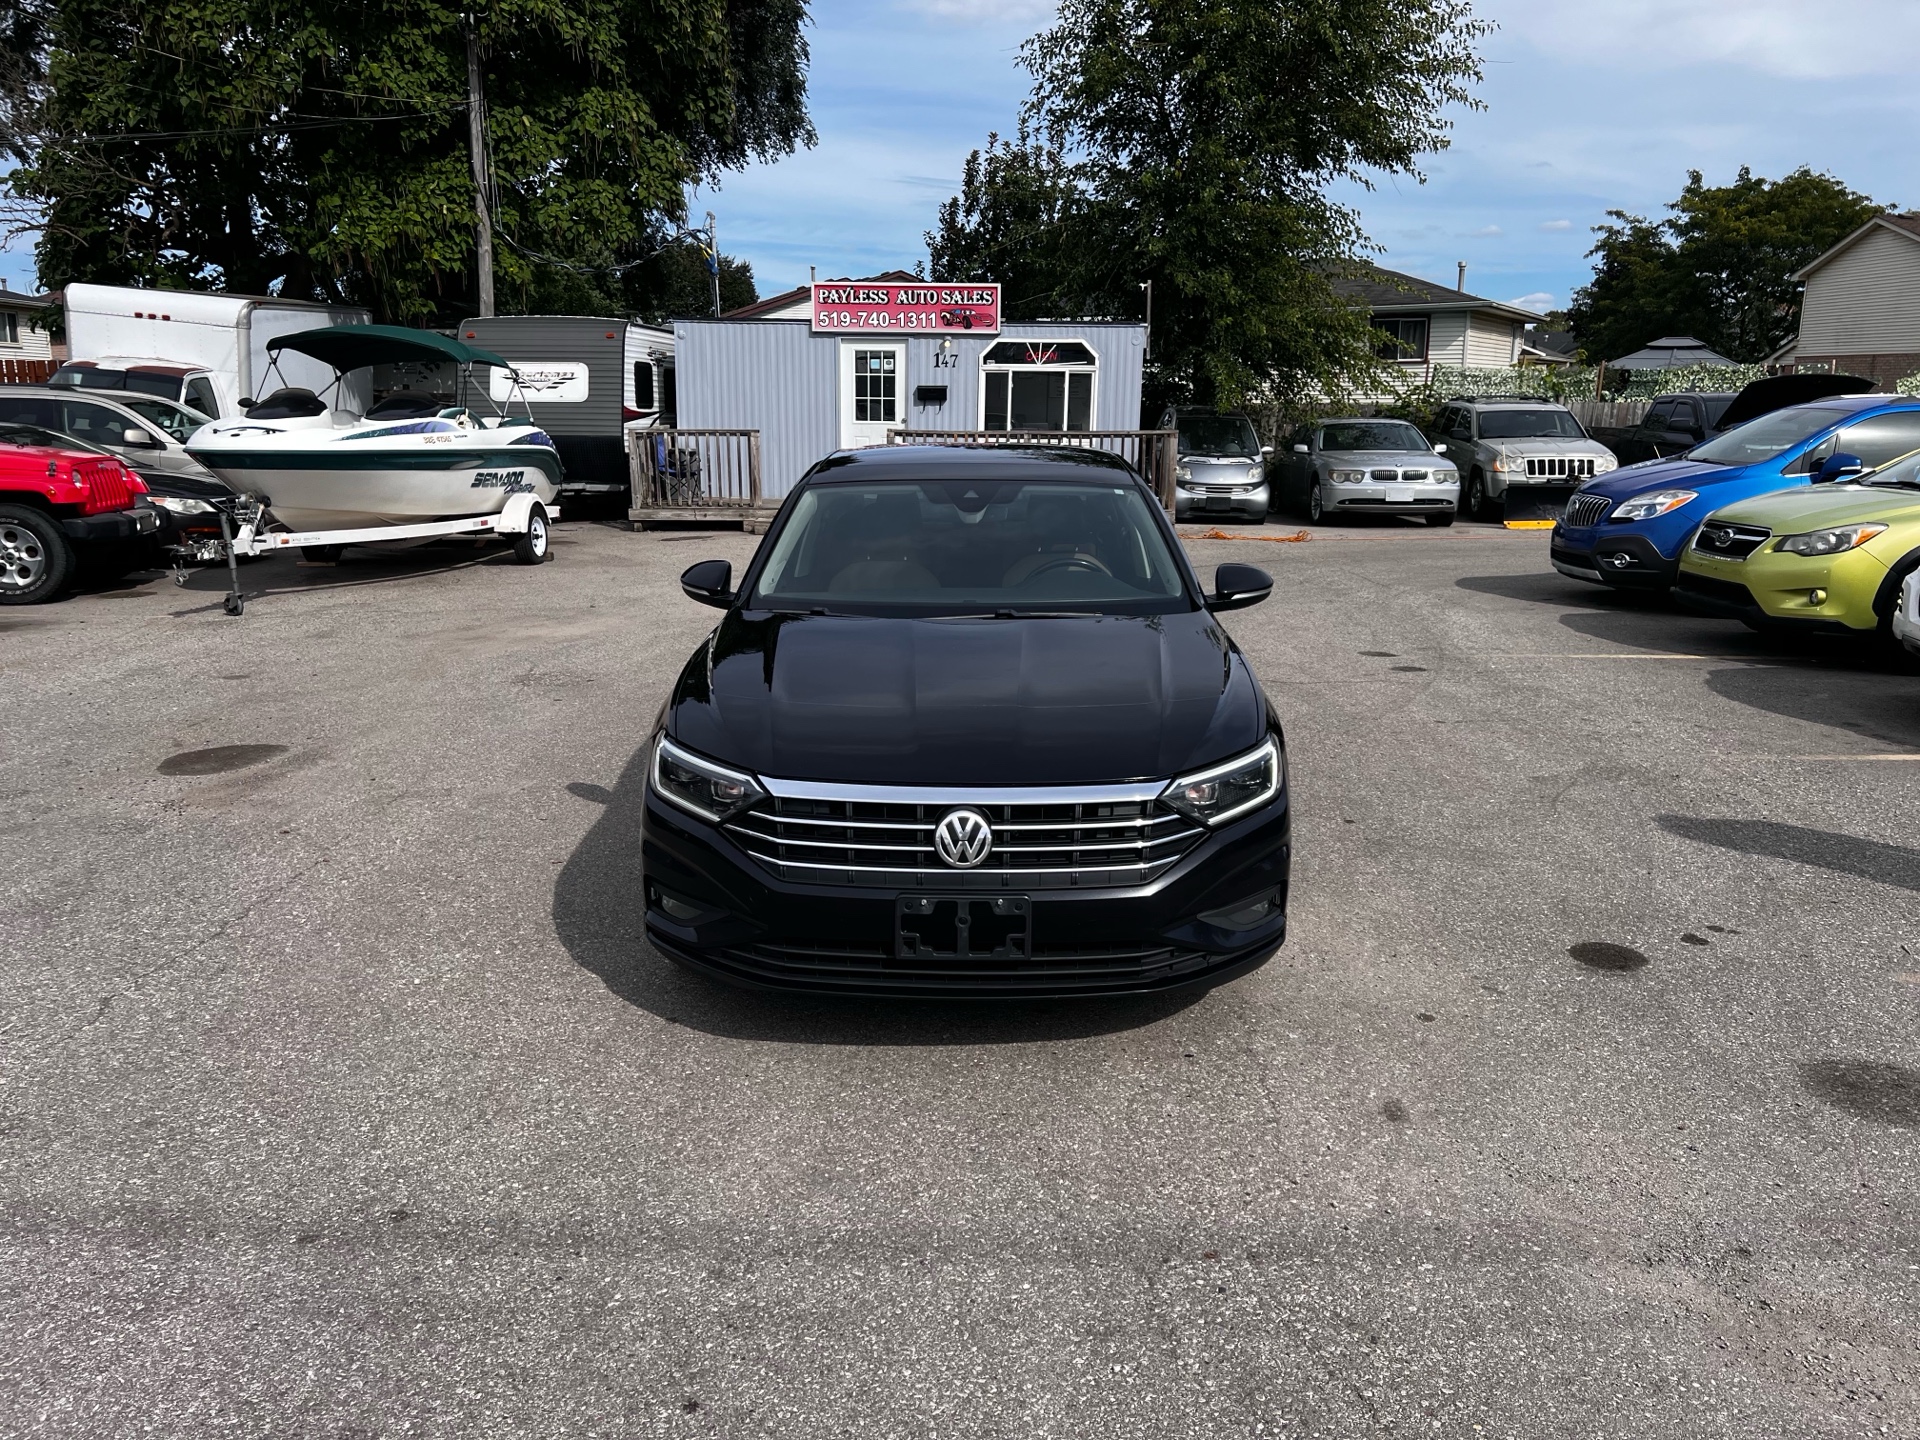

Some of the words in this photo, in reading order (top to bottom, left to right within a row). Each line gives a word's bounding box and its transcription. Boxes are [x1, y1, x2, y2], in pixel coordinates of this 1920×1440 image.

[818, 287, 889, 305] PAYLESS
[896, 289, 938, 305] AUTO
[941, 290, 994, 305] SALES
[818, 310, 937, 329] 519-740-1311
[933, 352, 959, 368] 147
[937, 811, 990, 867] VW
